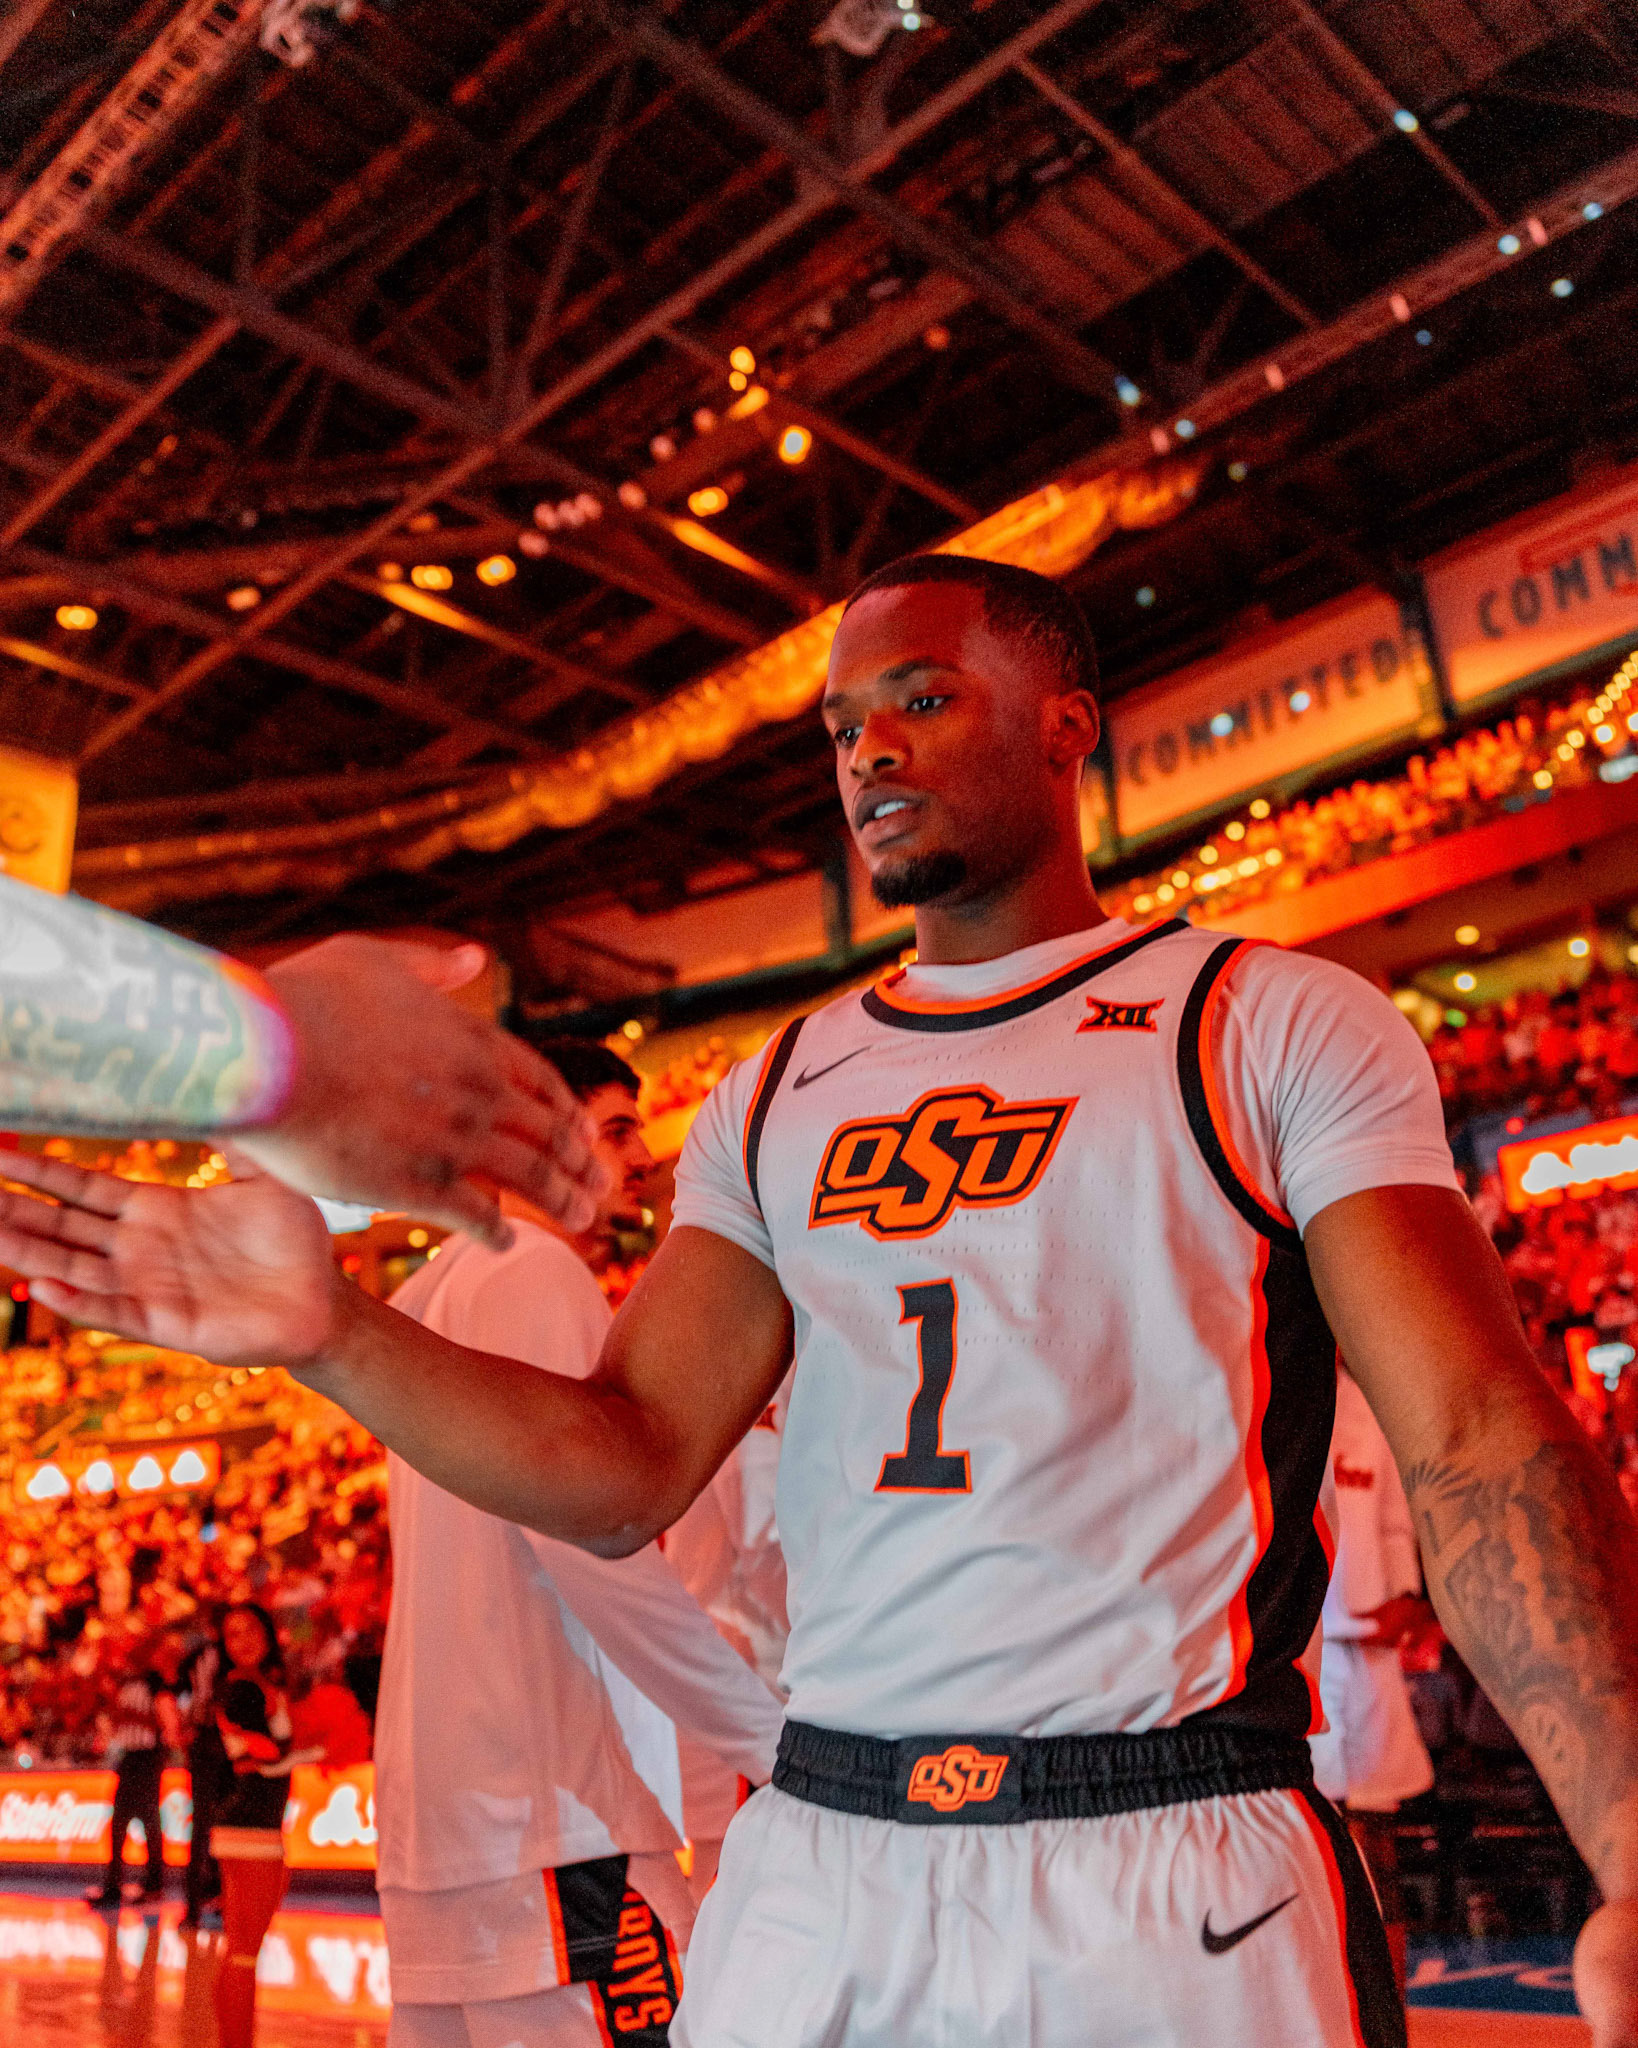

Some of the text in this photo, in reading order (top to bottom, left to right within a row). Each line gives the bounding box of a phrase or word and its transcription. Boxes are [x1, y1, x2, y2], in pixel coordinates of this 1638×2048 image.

[1079, 998, 1163, 1031] XII
[808, 1083, 1080, 1242] OSU
[874, 1273, 973, 1493] 1
[907, 1745, 1009, 1812] OSU
